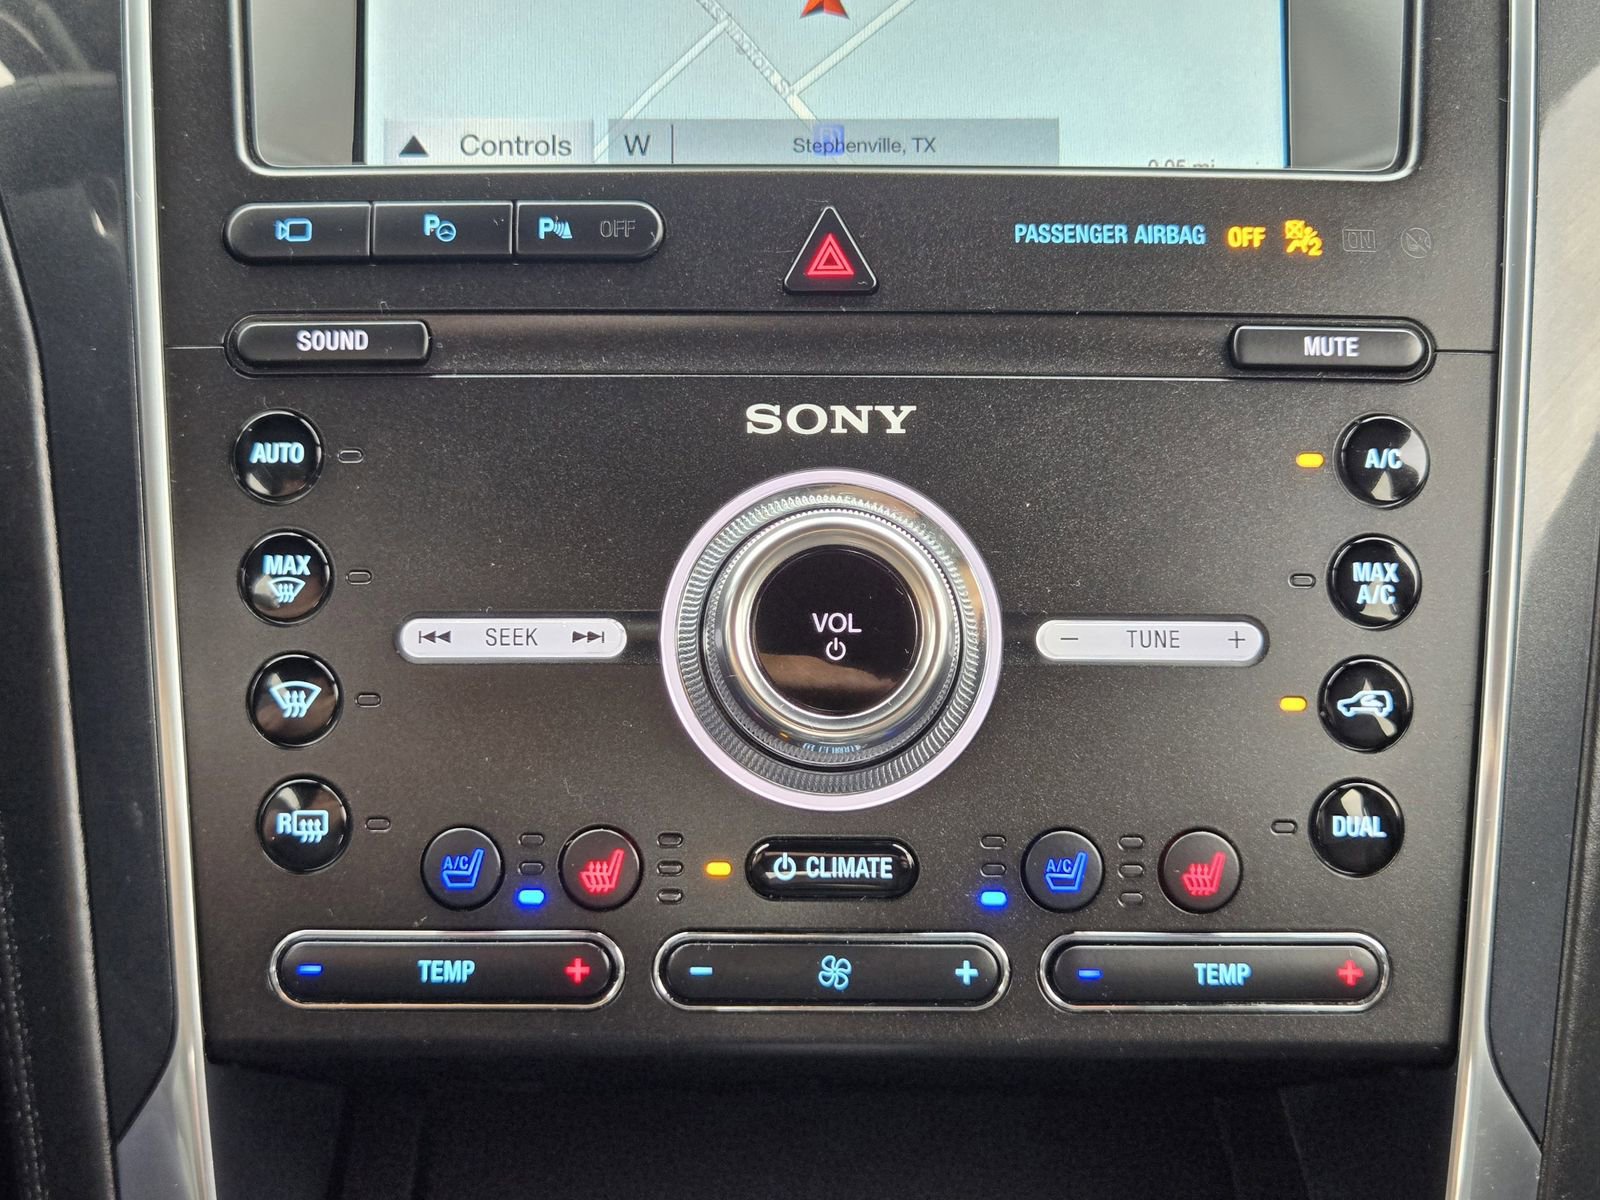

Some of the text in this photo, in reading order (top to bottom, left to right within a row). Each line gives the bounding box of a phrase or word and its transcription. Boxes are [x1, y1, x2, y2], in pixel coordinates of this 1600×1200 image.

[460, 134, 573, 156] Controls
[624, 134, 651, 156] W
[792, 137, 937, 156] Stephenville, TX
[600, 219, 636, 238] OFF
[1014, 223, 1266, 248] PASSENGER AIRBAG OFF
[296, 329, 369, 352] SOUND
[1303, 336, 1360, 358] MUTE
[745, 403, 918, 435] SONY
[250, 442, 306, 464] AUTO
[1364, 448, 1404, 470] A/C
[262, 554, 312, 577] MAX
[1352, 561, 1401, 583] MAX
[1356, 584, 1397, 606] A/C
[811, 612, 863, 634] VOL
[485, 628, 538, 647] SEEK
[1126, 630, 1181, 649] TUNE
[1331, 814, 1388, 839] DUAL
[442, 854, 469, 871] A/C
[805, 856, 893, 880] CLIMATE
[1045, 857, 1073, 874] A/C
[418, 960, 476, 985] TEMP
[1193, 962, 1252, 987] TEMP
